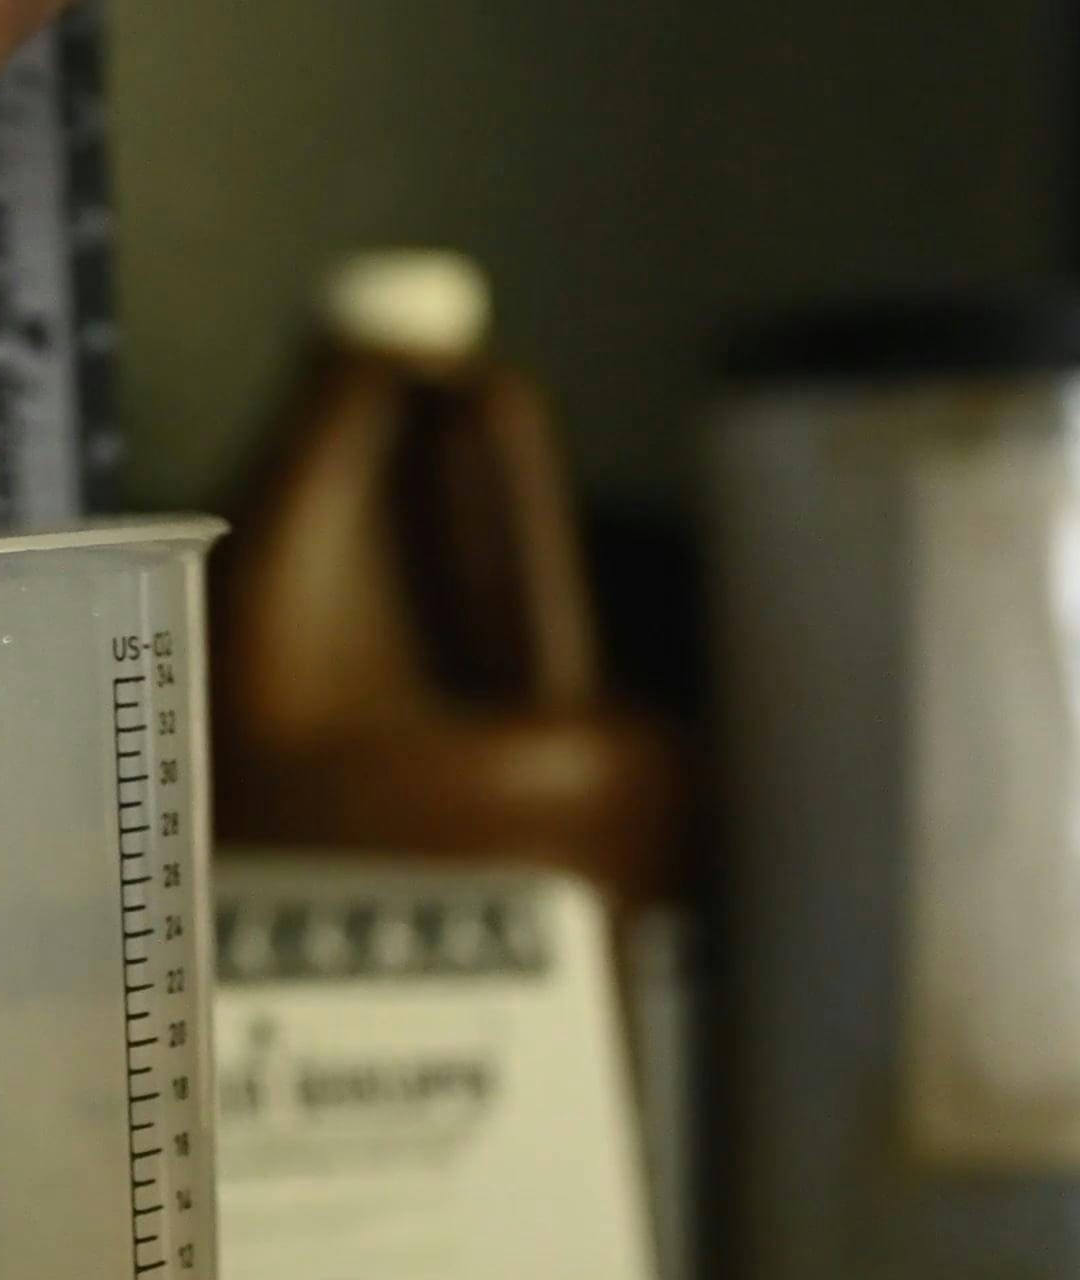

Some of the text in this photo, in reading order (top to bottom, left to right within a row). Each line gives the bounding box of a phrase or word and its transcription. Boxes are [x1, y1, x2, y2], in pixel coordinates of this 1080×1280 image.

[157, 663, 175, 687] 34
[158, 710, 176, 735] 32
[165, 915, 183, 940] 24
[167, 967, 184, 994] 22
